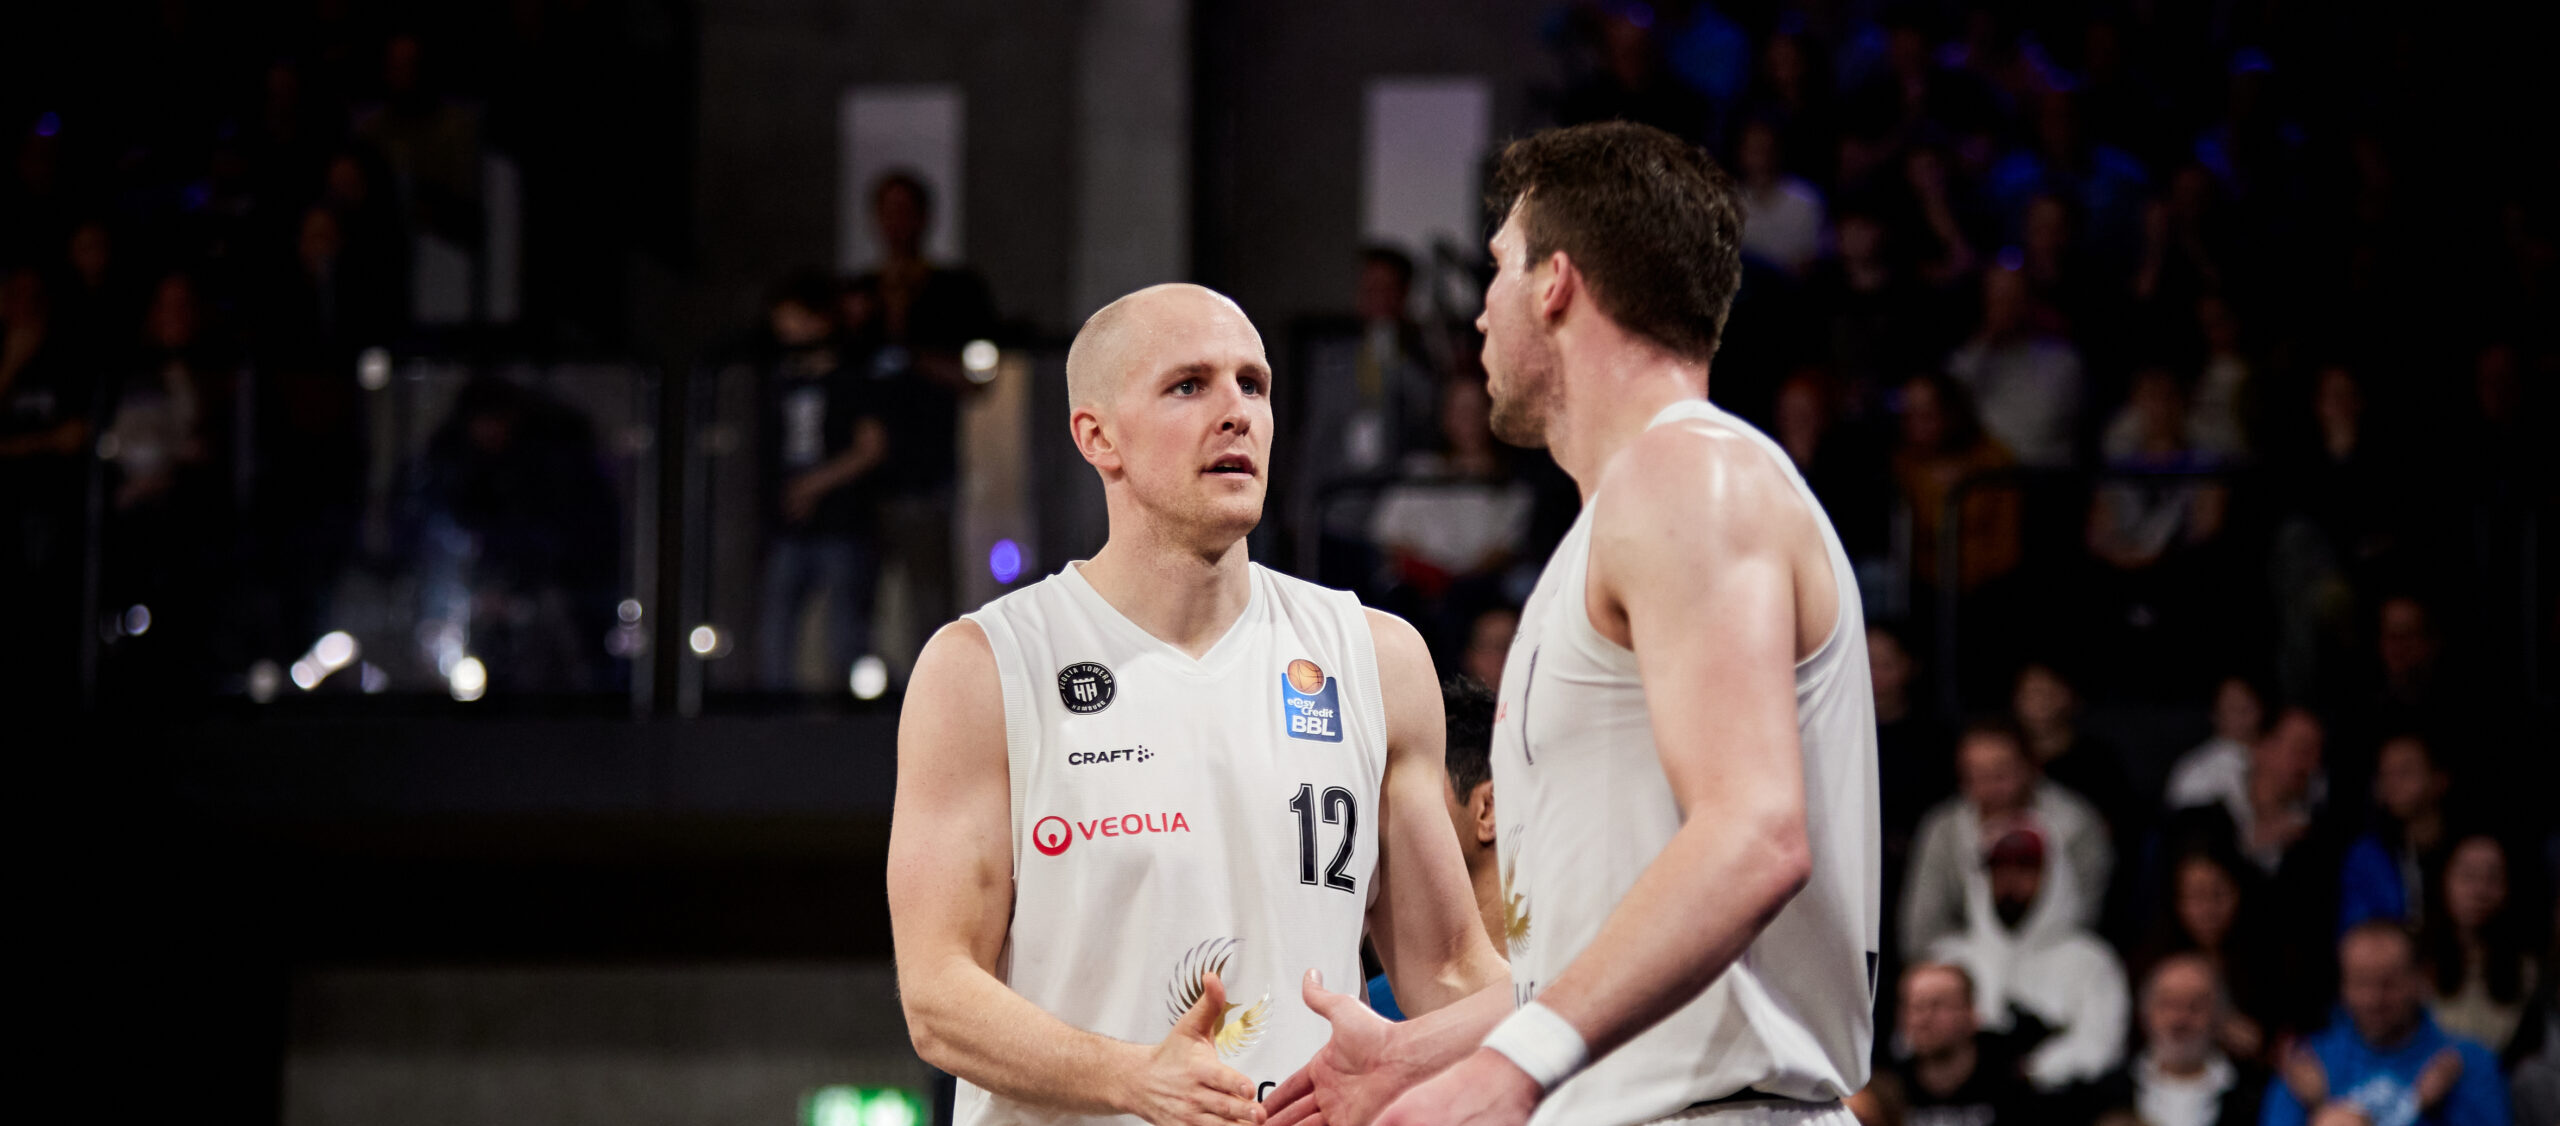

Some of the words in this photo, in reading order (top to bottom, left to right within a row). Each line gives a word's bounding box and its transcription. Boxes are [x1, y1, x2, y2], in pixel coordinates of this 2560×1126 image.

[1082, 665, 1112, 685] TOWERS
[1072, 700, 1106, 712] HAMBURG
[1302, 706, 1334, 718] Credit
[1292, 714, 1336, 737] BBL
[1068, 749, 1134, 766] CRAFT
[1077, 812, 1190, 840] VEOLIA
[1289, 783, 1358, 894] 12
